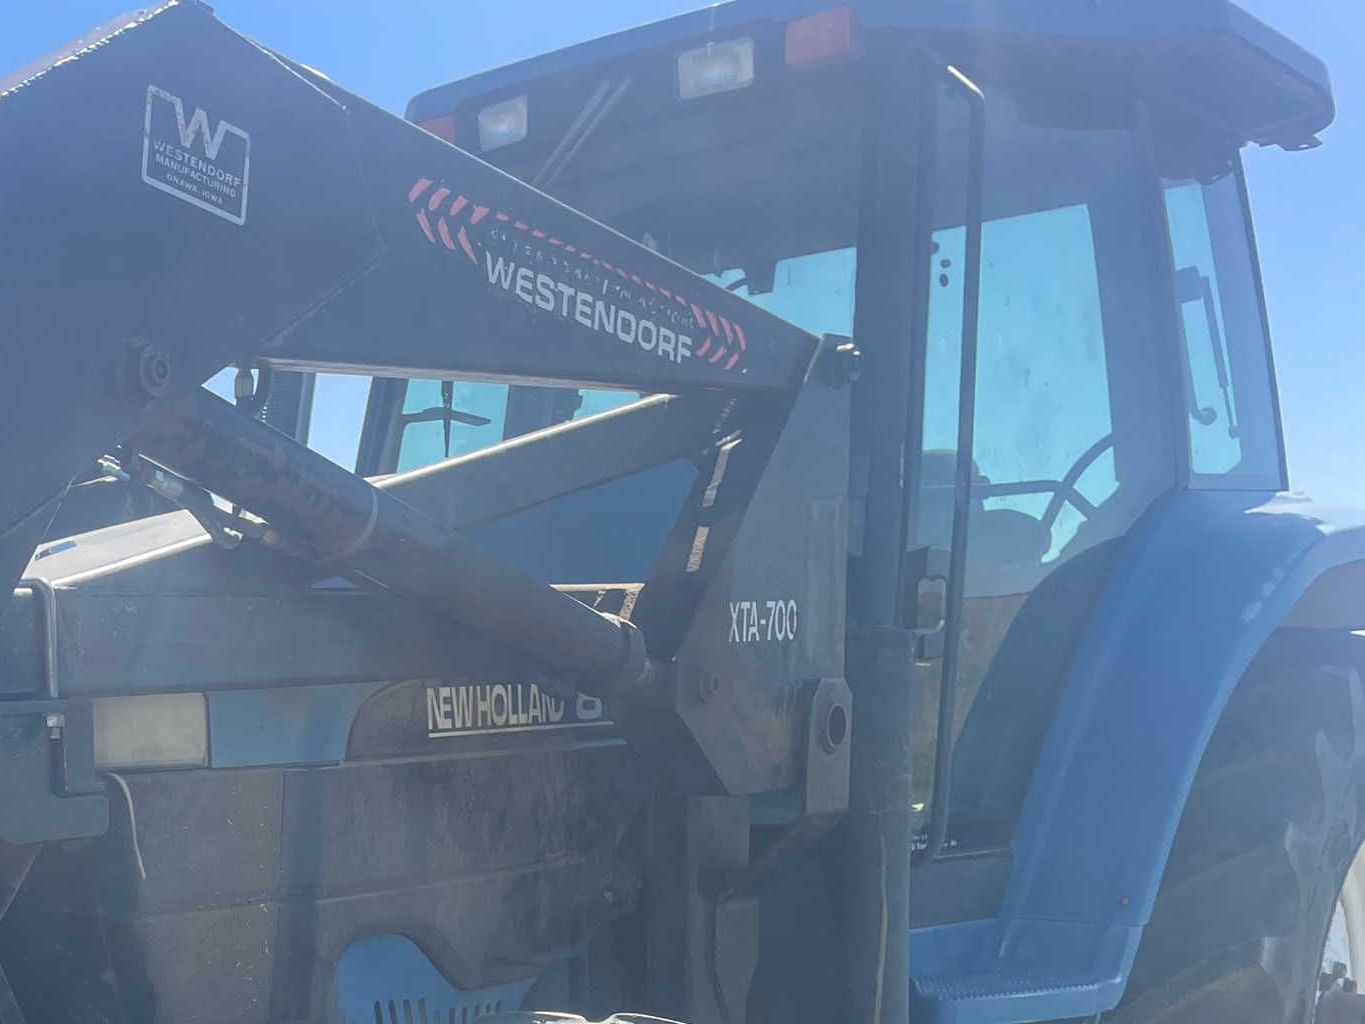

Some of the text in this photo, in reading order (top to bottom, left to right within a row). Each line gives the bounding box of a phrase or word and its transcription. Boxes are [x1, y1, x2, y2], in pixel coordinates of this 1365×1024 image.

[153, 138, 242, 187] WESTENDORF
[155, 153, 236, 198] MANUFACTURING
[202, 189, 223, 205] IOWA
[485, 250, 693, 364] WESTENDORF
[728, 599, 798, 643] XTA-700
[426, 686, 474, 730] NEW
[476, 683, 565, 727] HOLLAND
